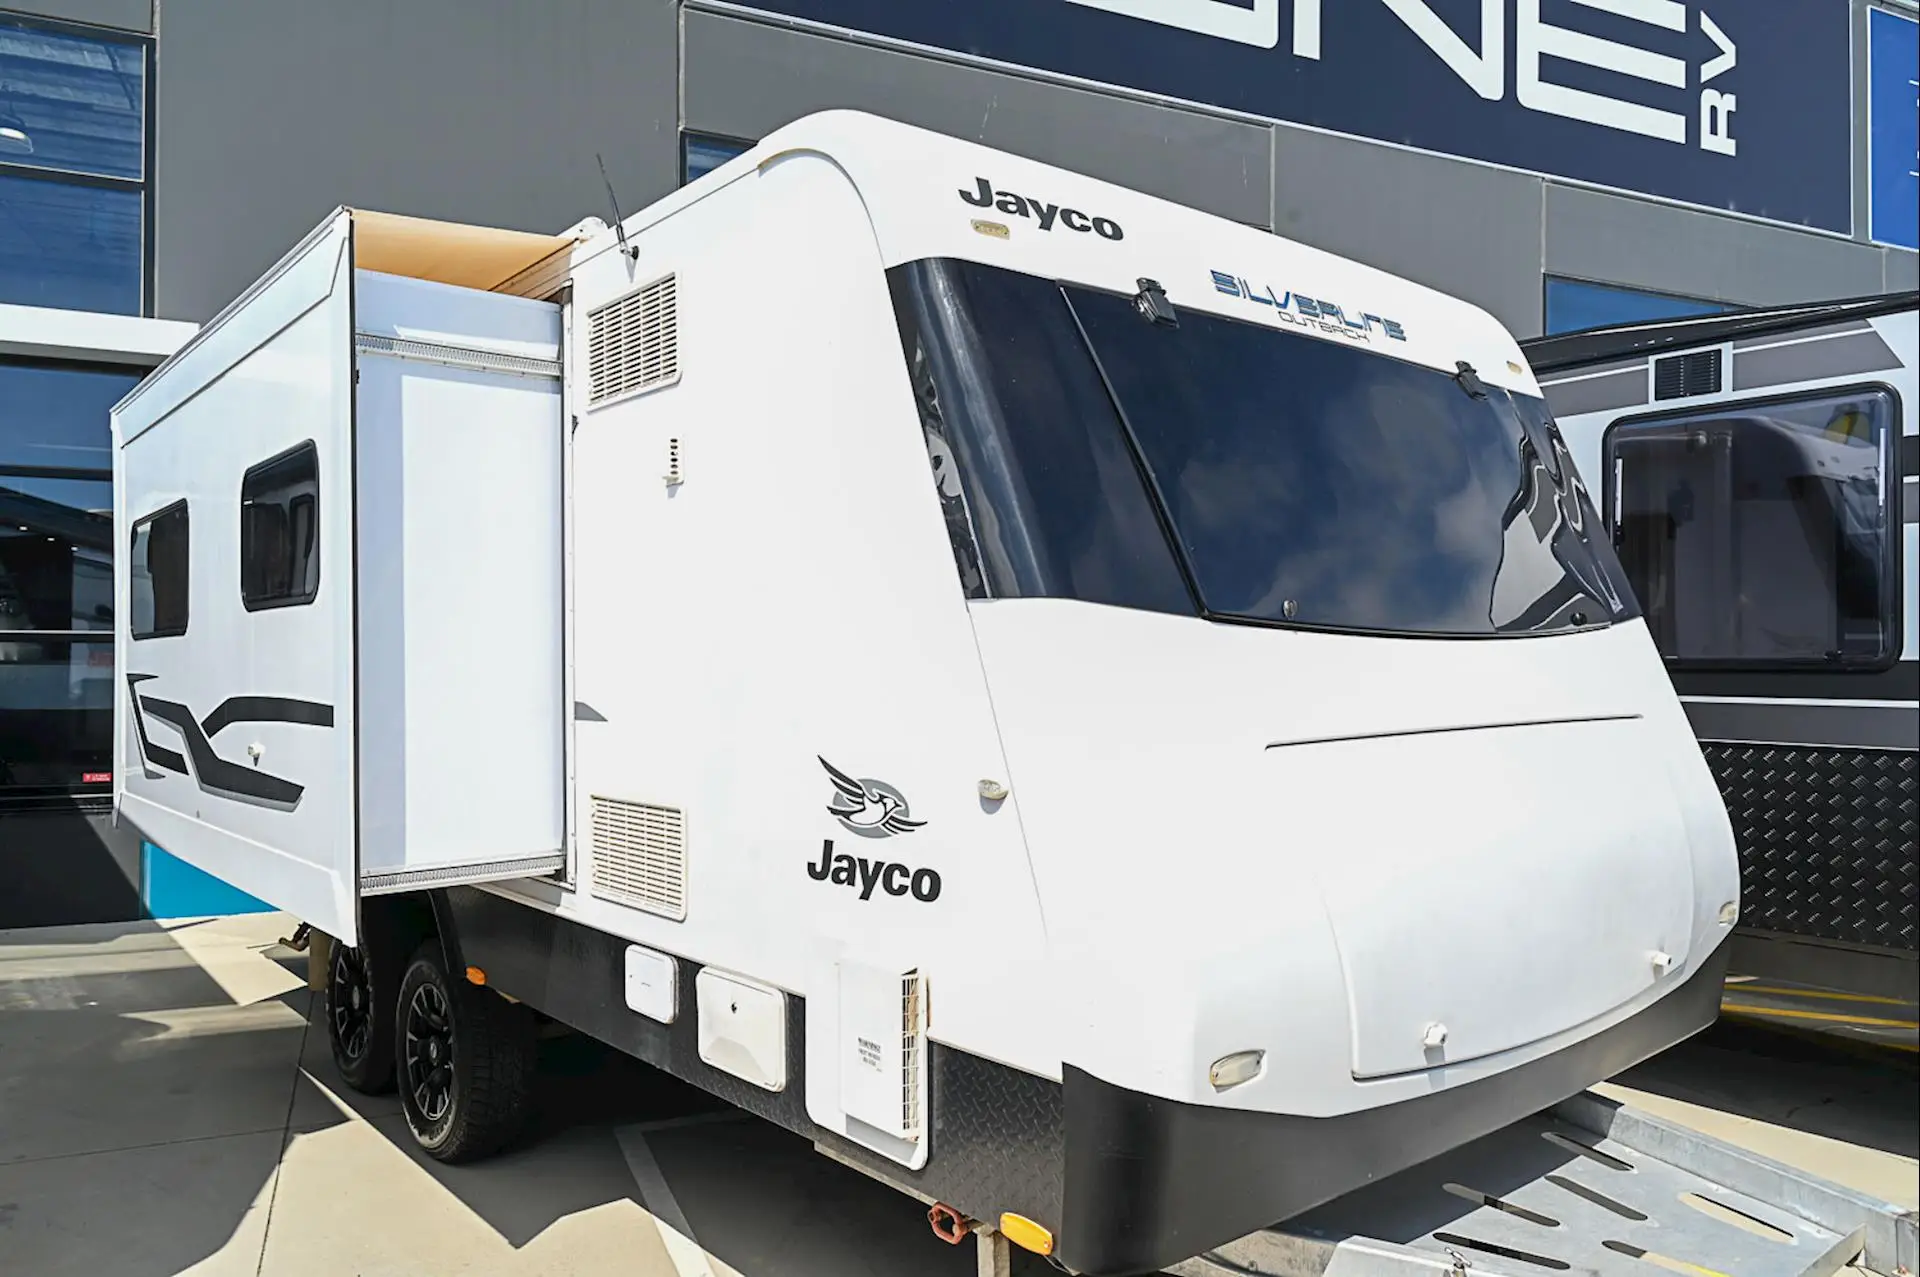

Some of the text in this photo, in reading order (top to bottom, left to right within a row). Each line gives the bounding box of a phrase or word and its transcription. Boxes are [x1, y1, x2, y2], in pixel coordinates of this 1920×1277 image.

[1066, 0, 1686, 144] NE
[1701, 10, 1736, 156] RV
[958, 177, 1123, 241] Jayco
[1209, 269, 1407, 341] SILVERLINE
[1278, 311, 1370, 343] OUTBACK
[807, 839, 941, 902] Jayco
